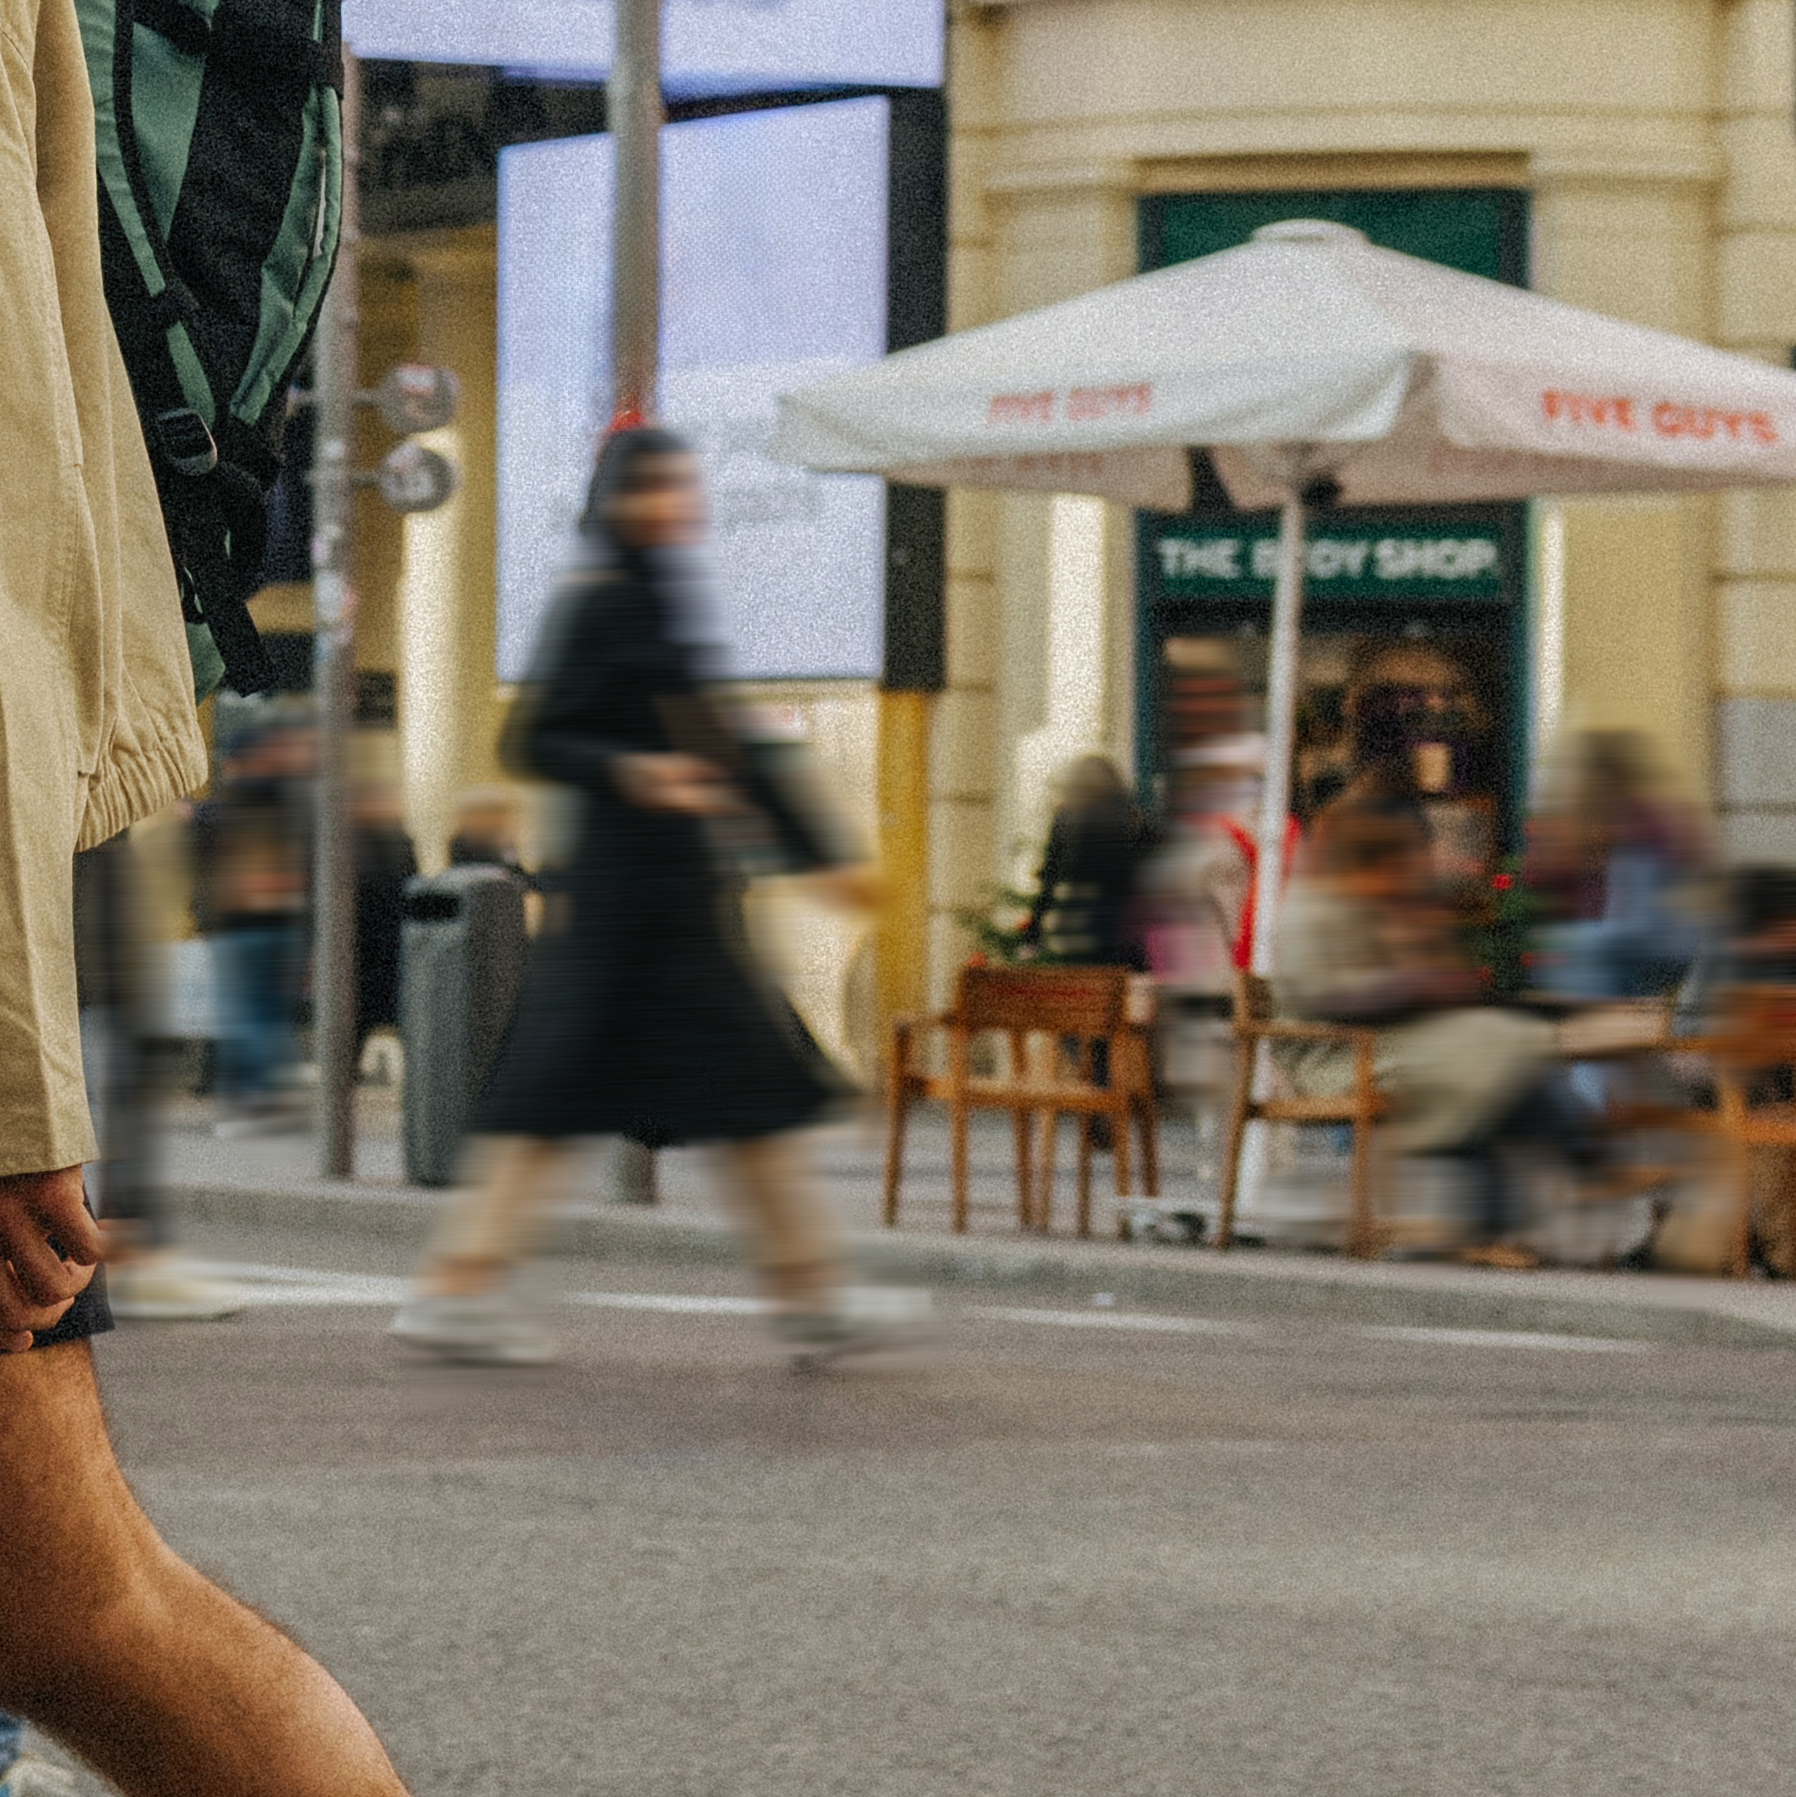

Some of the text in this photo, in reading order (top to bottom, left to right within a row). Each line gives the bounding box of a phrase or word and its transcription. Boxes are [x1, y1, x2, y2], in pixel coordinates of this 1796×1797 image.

[1542, 389, 1778, 445] FIVE GUYS
[1159, 539, 1239, 578] THE
